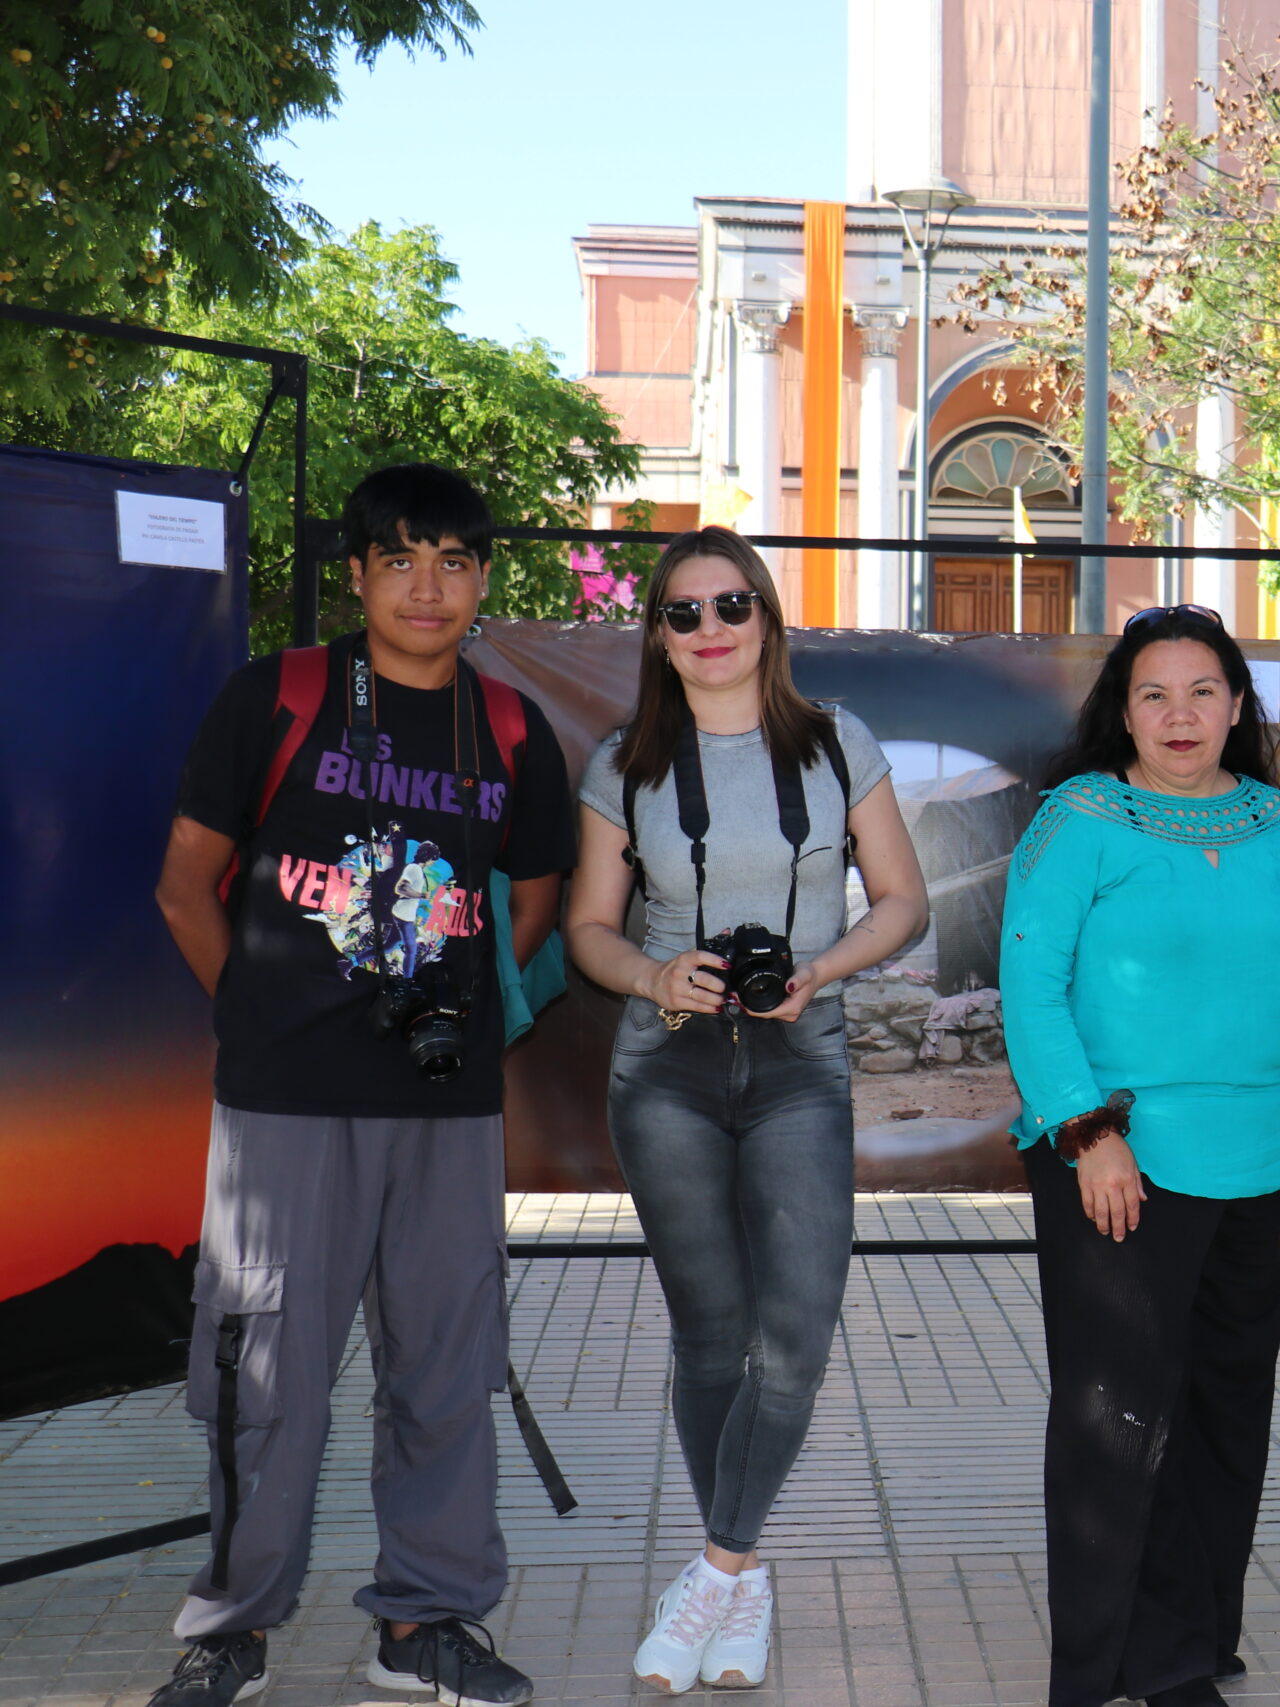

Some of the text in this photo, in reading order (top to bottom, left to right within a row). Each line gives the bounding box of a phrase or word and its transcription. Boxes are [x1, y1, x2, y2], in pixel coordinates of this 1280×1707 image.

[355, 658, 368, 706] SONY
[340, 727, 392, 761] LS
[314, 751, 506, 823] BUNKERS
[279, 854, 353, 914] VEN
